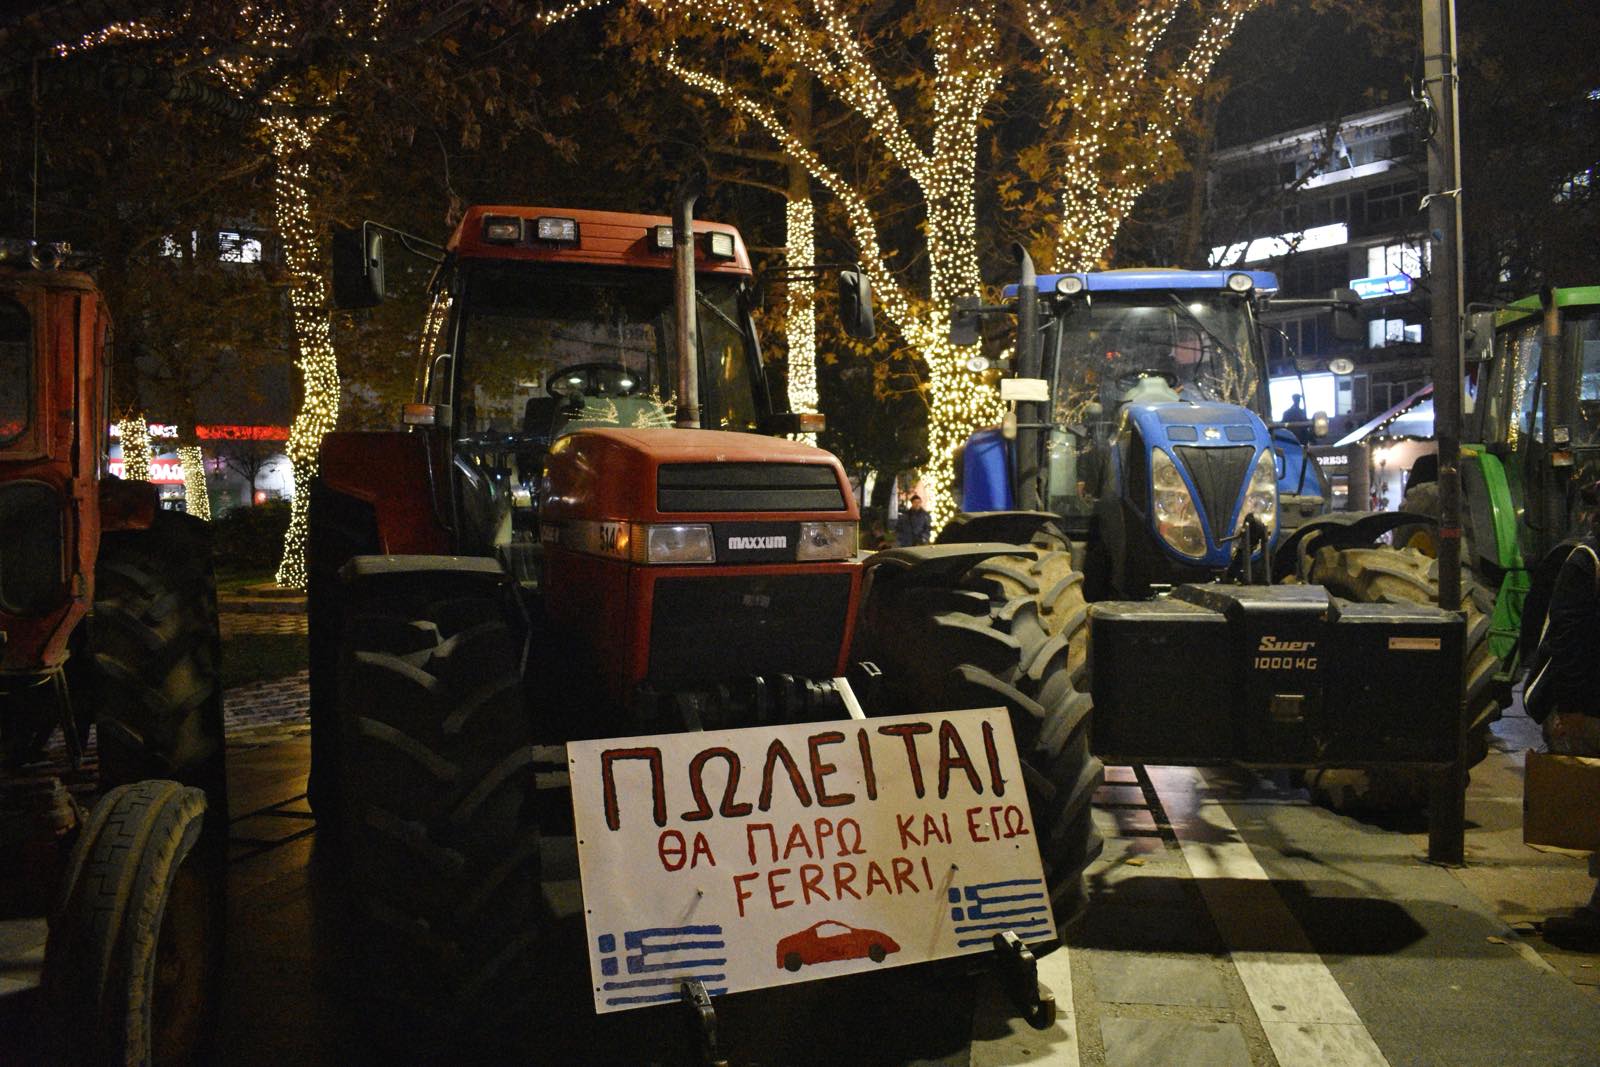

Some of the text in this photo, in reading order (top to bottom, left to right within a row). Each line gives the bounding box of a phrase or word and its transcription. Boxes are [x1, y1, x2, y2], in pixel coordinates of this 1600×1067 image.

[728, 535, 787, 550] MAXXUM
[1258, 635, 1316, 652] Suer
[1254, 657, 1318, 670] 1000 KG
[600, 719, 1007, 831] ΠΩΛΕΙΤΑΙ
[658, 804, 1030, 872] ΘΑ ΠΑΡΩ ΚΑΙ ΕΓΩ
[733, 856, 934, 918] FERRARI
